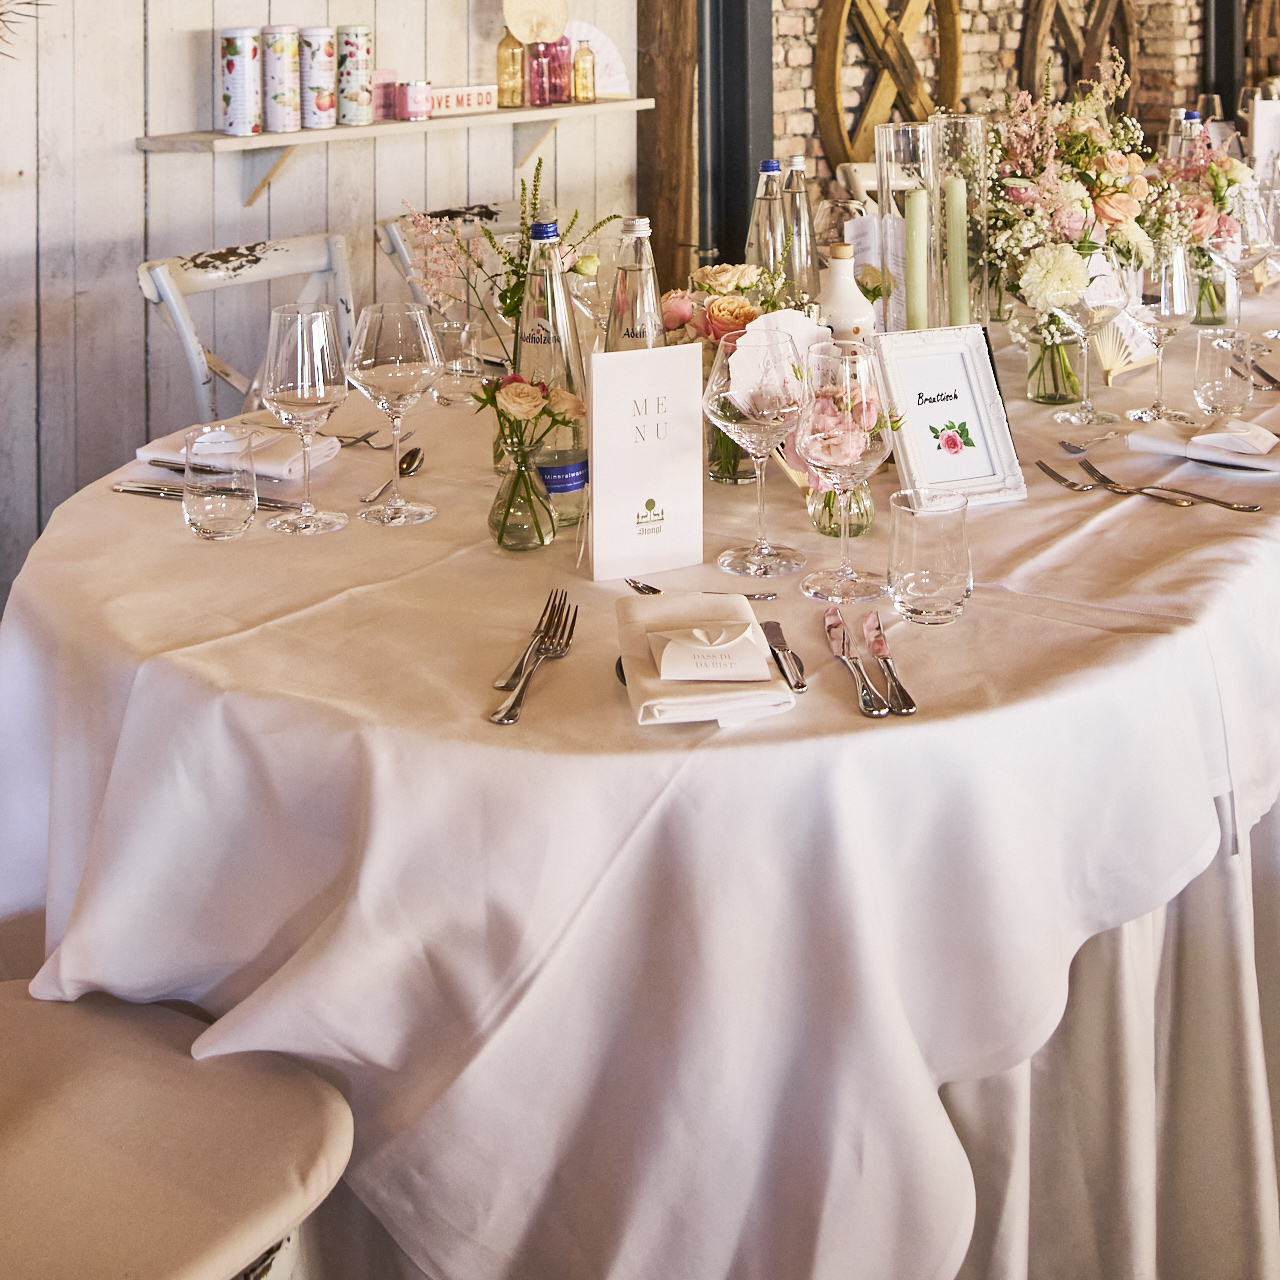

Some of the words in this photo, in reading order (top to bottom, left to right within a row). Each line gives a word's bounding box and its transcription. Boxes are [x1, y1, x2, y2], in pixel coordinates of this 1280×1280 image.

[430, 94, 451, 110] OVE
[456, 93, 472, 108] ME
[477, 91, 493, 106] DO
[637, 525, 662, 536] Stangl
